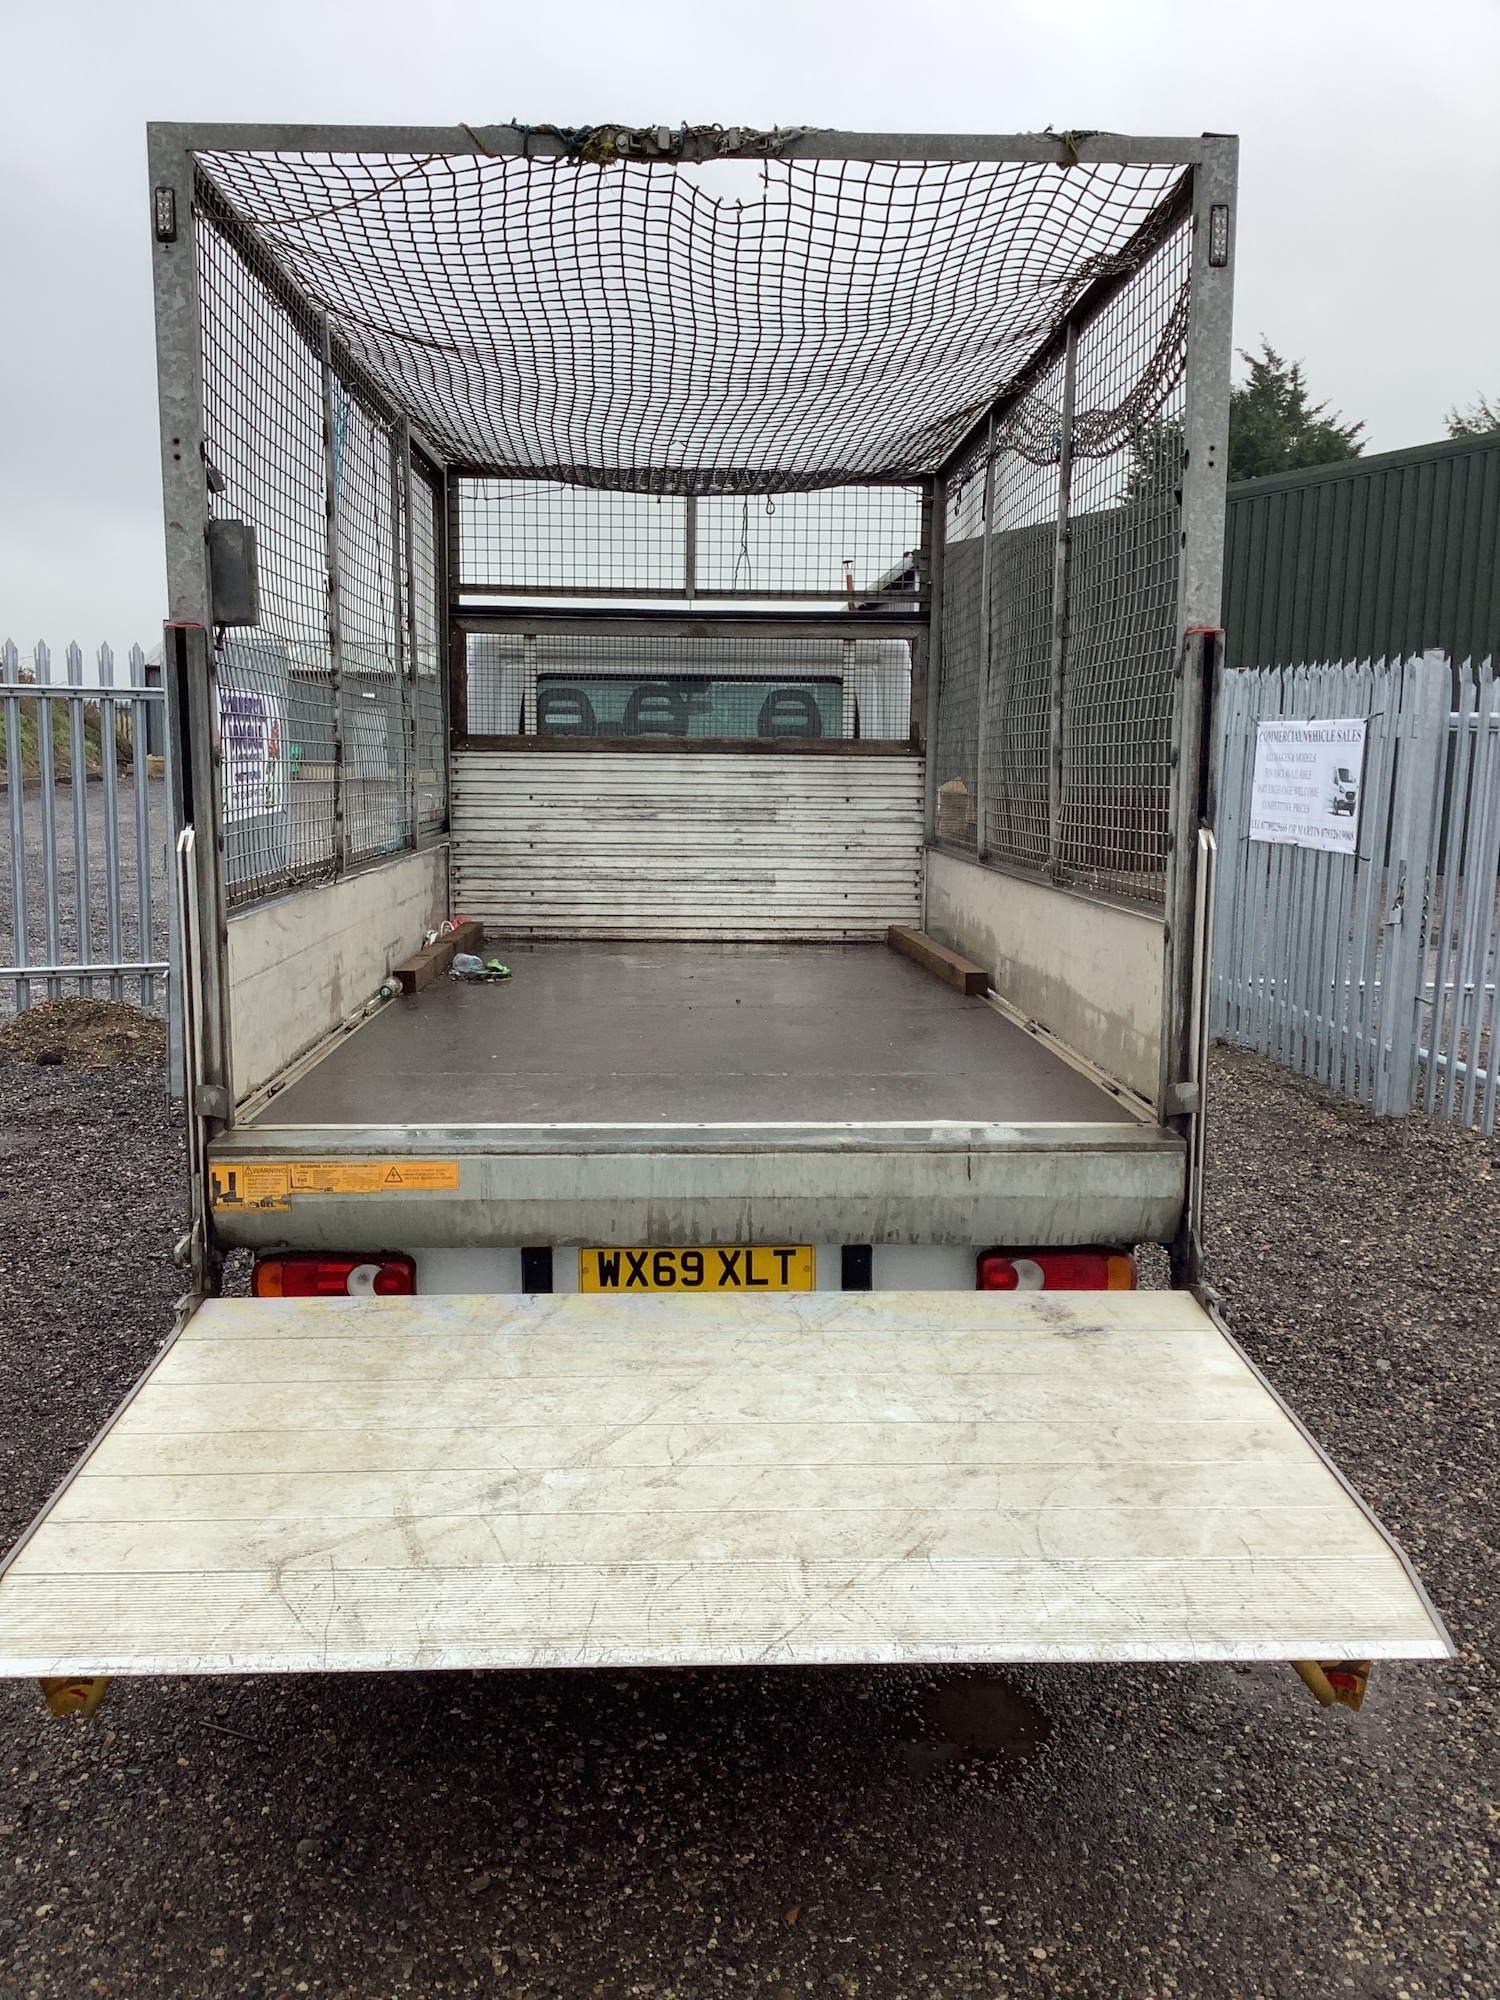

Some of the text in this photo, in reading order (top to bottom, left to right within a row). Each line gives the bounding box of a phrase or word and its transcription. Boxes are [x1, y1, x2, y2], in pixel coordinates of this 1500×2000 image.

[1259, 729, 1362, 743] COMMERCIAL VEHICLE SALES
[1295, 754, 1317, 763] MODELS
[1294, 786, 1319, 798] WELCOME
[1288, 823, 1297, 834] OR
[1297, 824, 1320, 837] MARTIN
[598, 1249, 797, 1287] WX69 XLT
